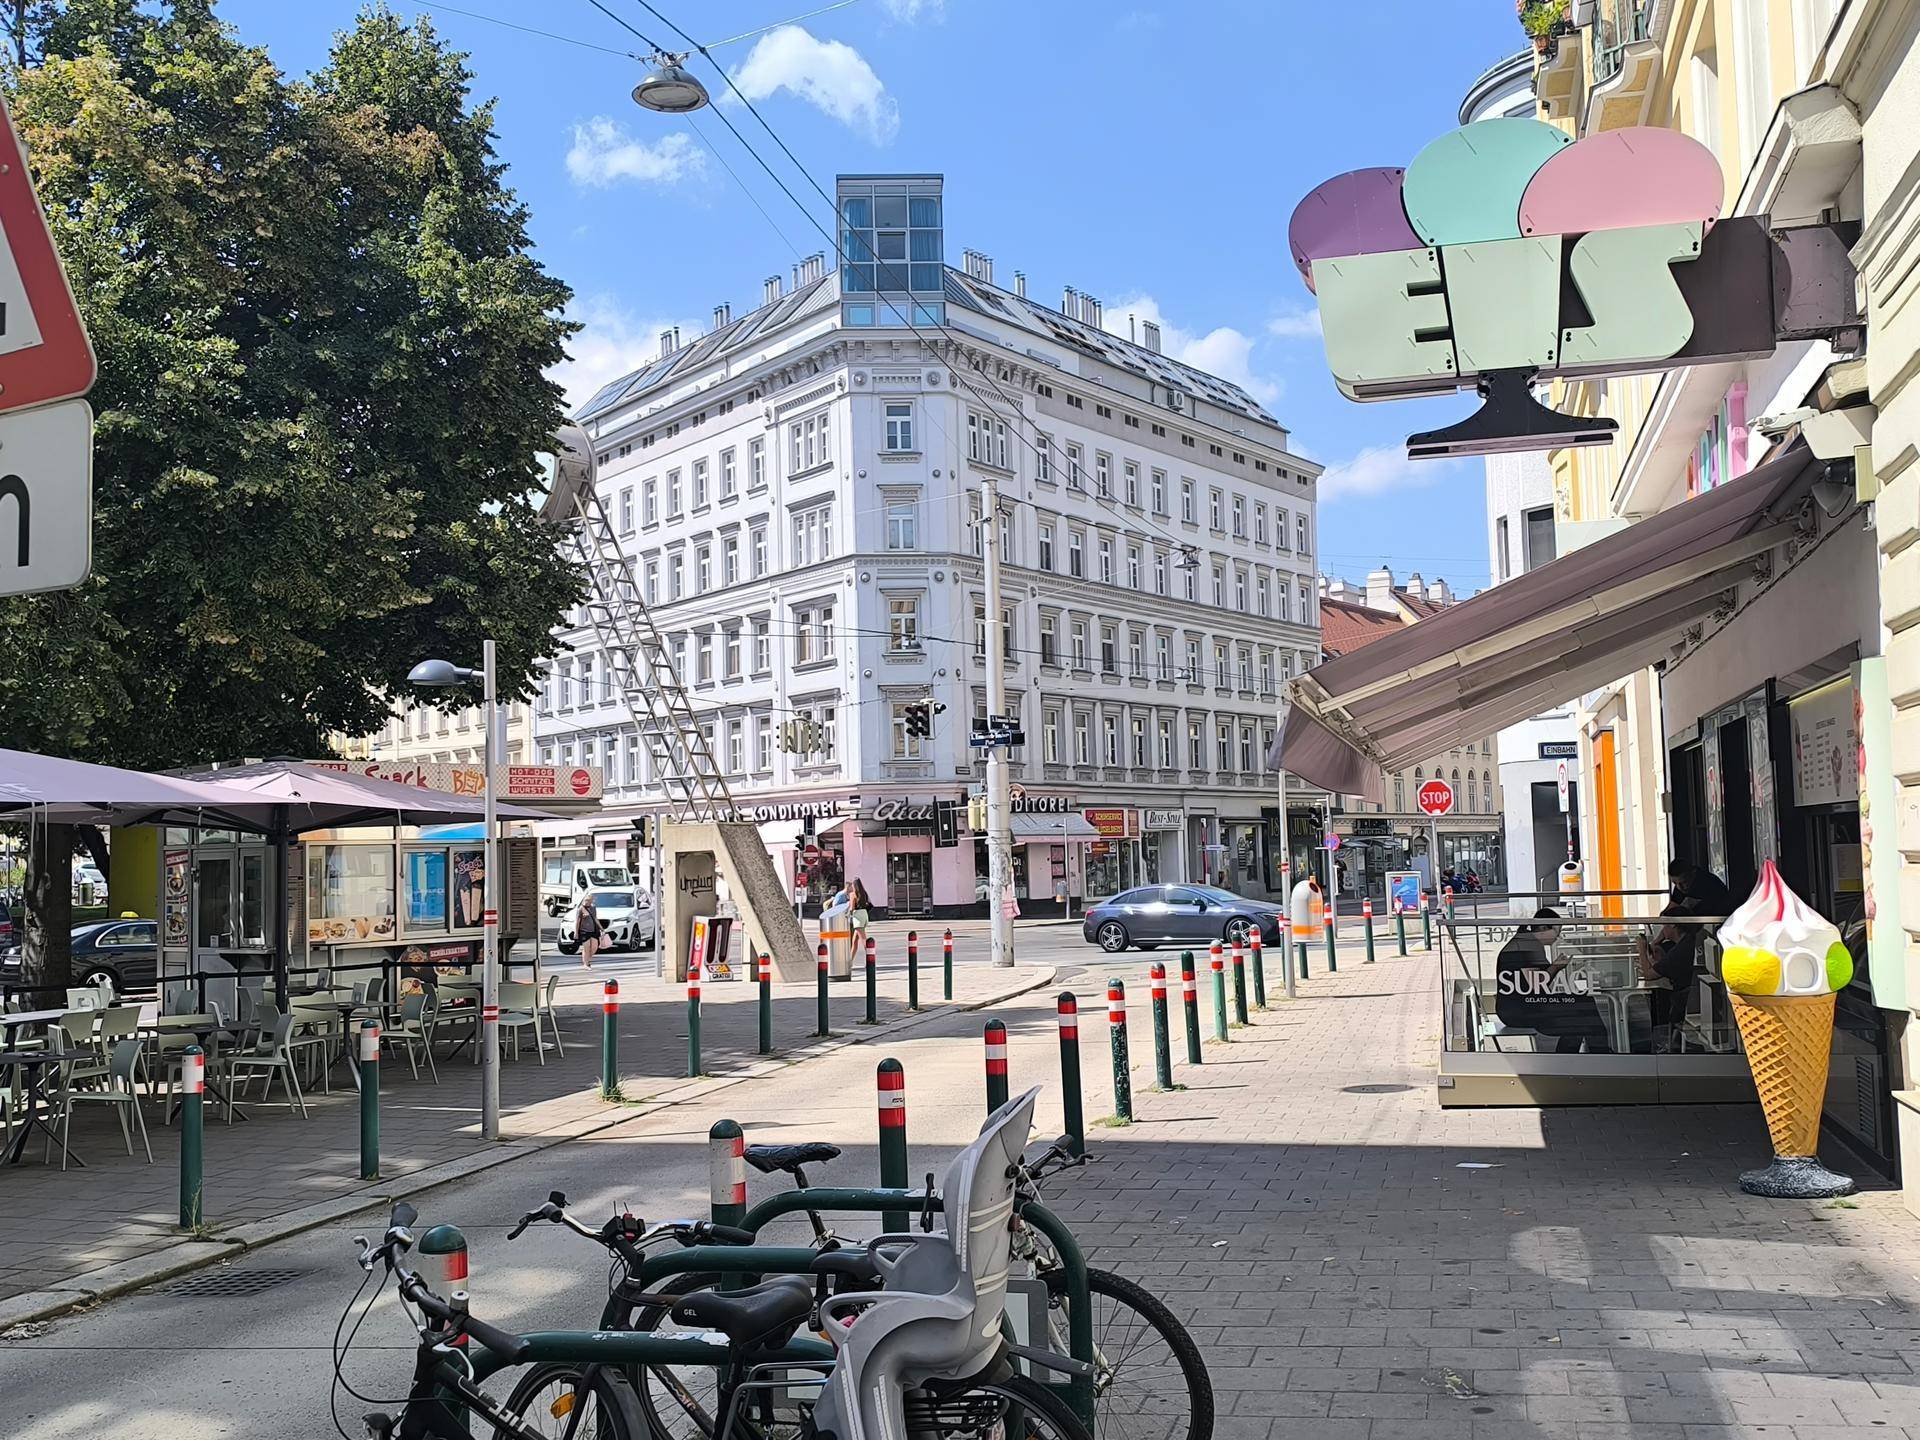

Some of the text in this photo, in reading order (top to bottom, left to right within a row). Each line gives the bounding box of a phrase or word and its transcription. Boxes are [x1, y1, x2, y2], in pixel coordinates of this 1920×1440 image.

[1312, 221, 1703, 381] EIS
[1546, 746, 1576, 754] EINBAHN
[511, 768, 553, 776] HOT-DOG
[511, 777, 553, 785] SCHNITZEL
[1421, 791, 1450, 804] STOP
[752, 800, 836, 821] KONDITOREI
[1498, 967, 1602, 996] SURACE
[683, 1308, 697, 1317] GEL
